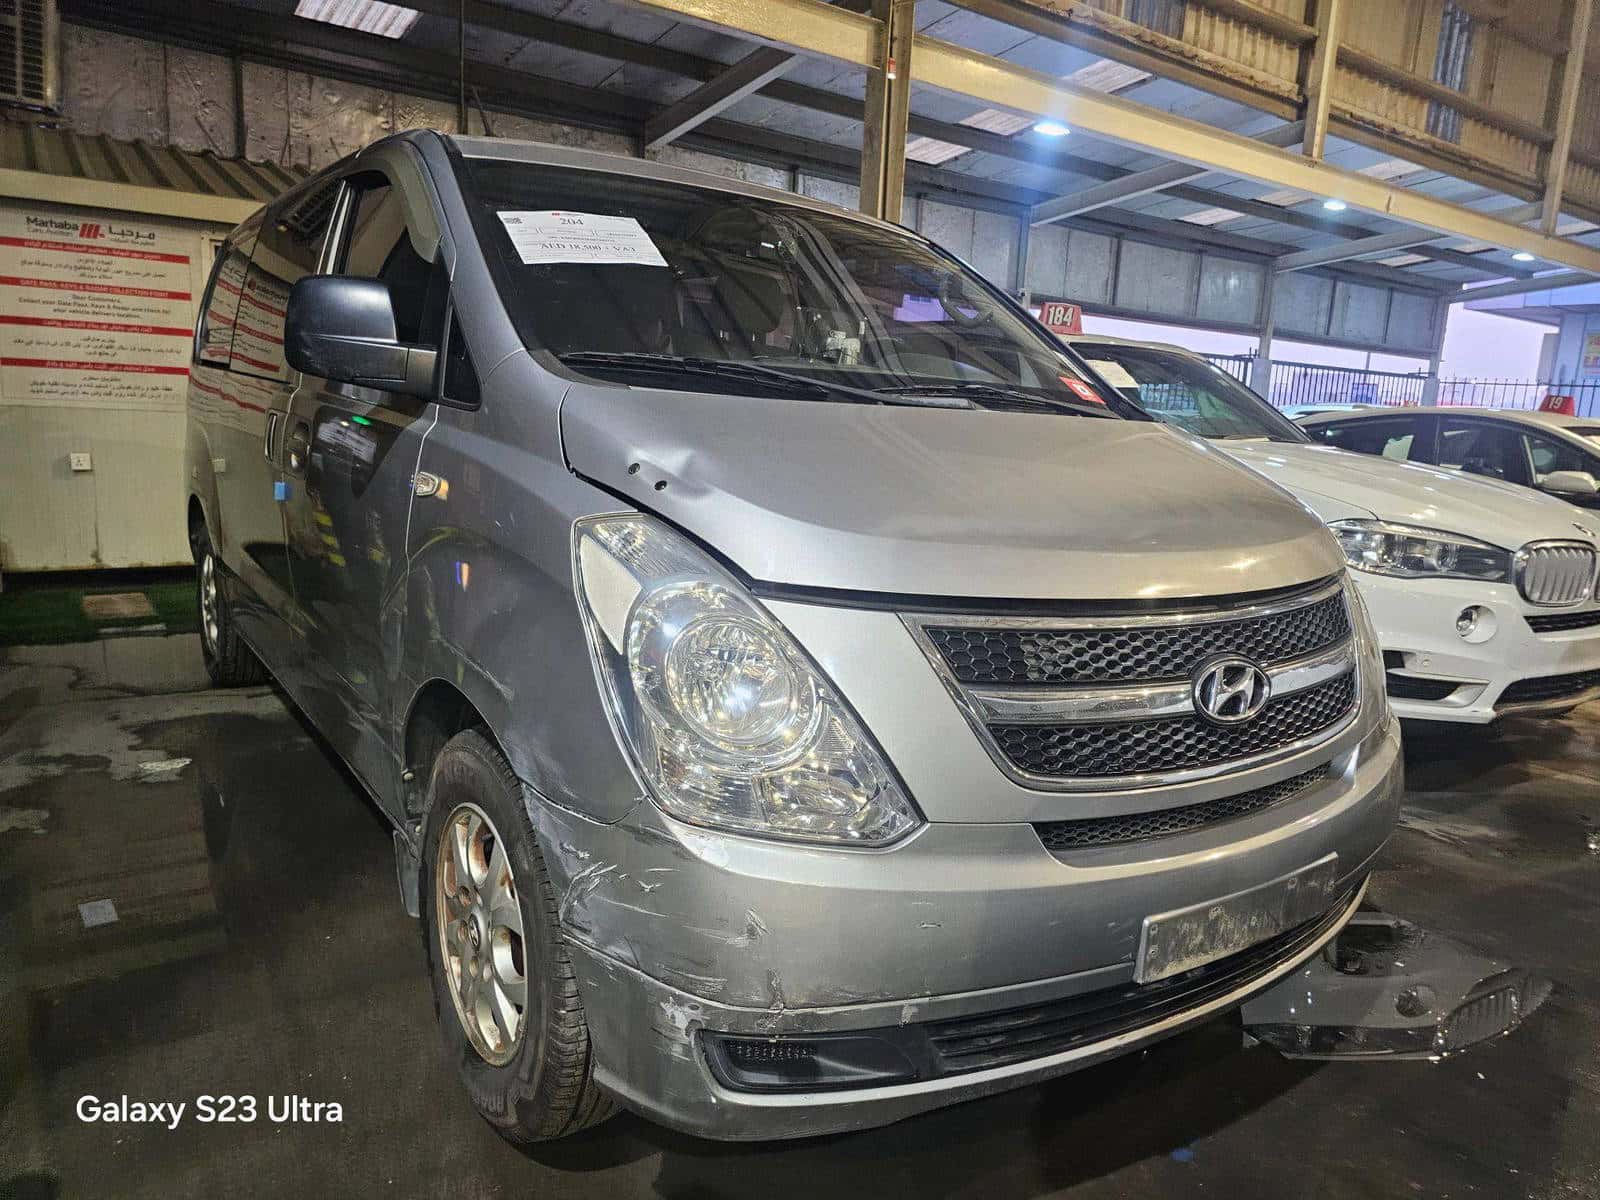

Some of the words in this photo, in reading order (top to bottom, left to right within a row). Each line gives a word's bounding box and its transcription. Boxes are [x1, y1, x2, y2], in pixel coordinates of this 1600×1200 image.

[25, 216, 79, 231] Marhaba
[108, 224, 155, 240] مرحبا
[1048, 305, 1074, 326] 184
[1549, 396, 1564, 409] 19
